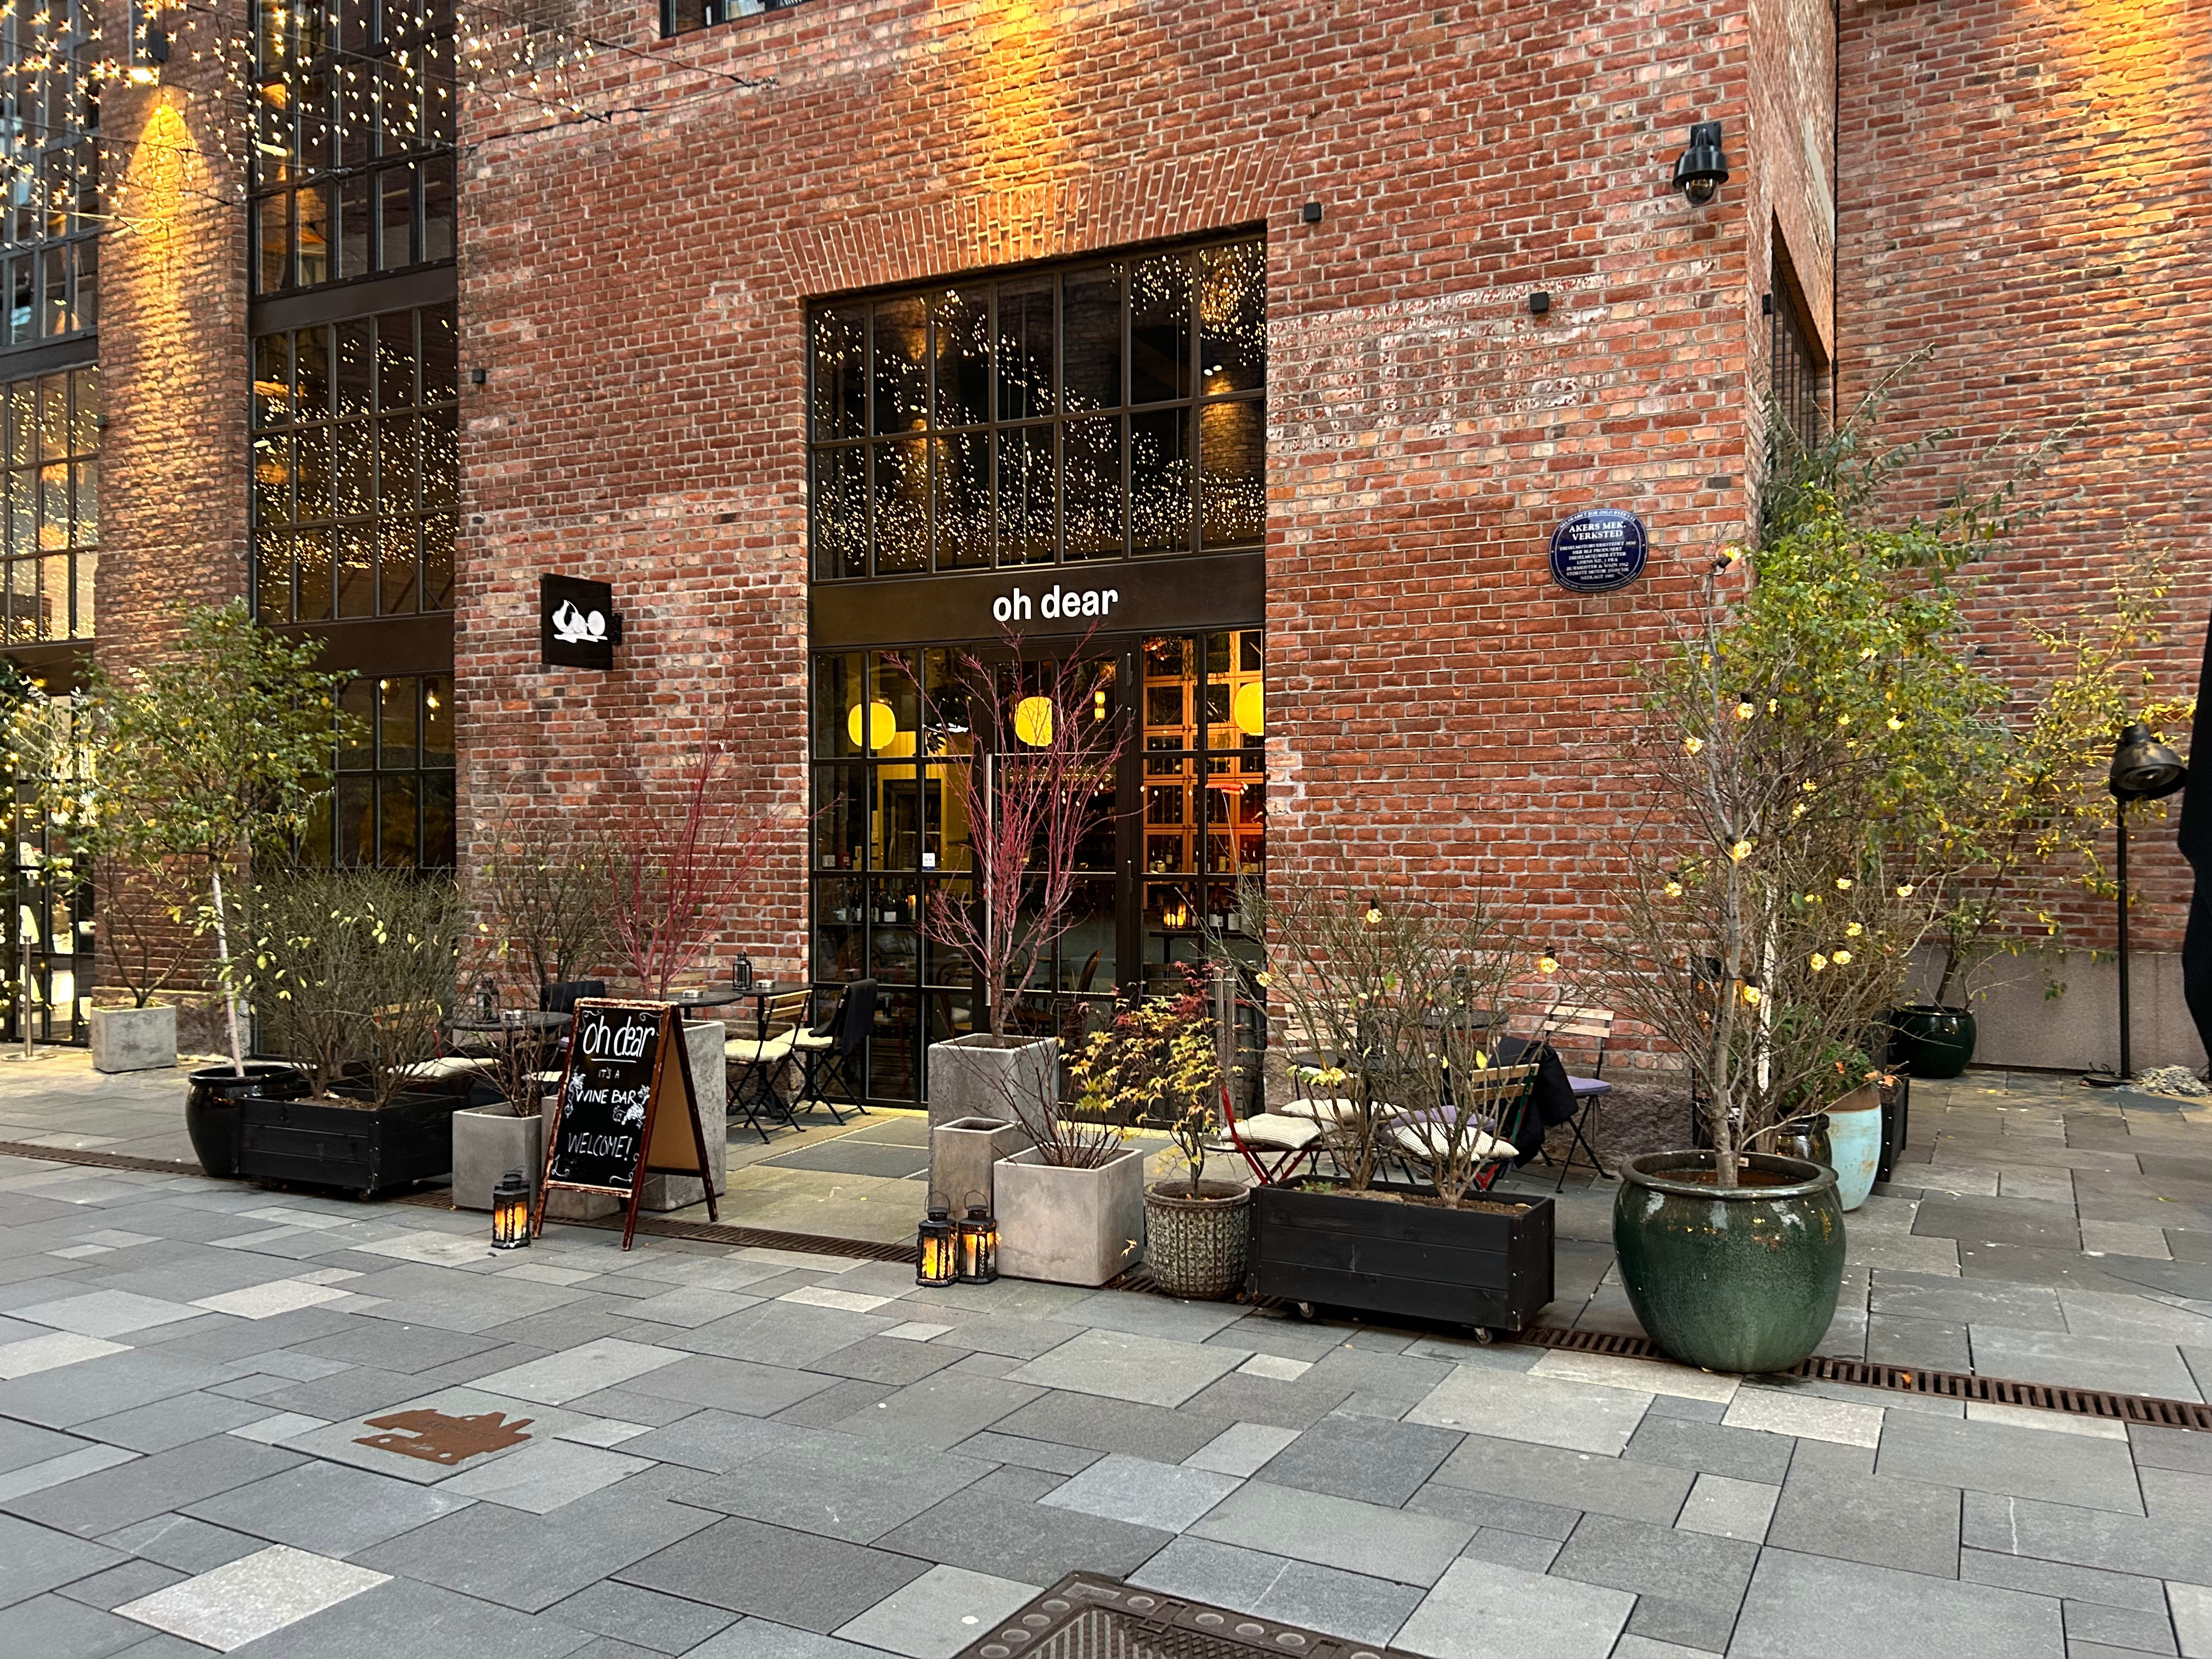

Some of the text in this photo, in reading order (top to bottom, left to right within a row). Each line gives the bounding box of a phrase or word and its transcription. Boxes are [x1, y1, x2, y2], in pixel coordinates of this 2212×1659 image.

[1568, 521, 1626, 533] AKERS MEK.
[1572, 530, 1623, 541] VERKSTED
[993, 584, 1119, 622] oh dear
[583, 1015, 656, 1058] oh dear
[614, 1069, 620, 1079] A
[574, 1088, 636, 1105] WINE BAR
[568, 1132, 633, 1161] WELCOME!
